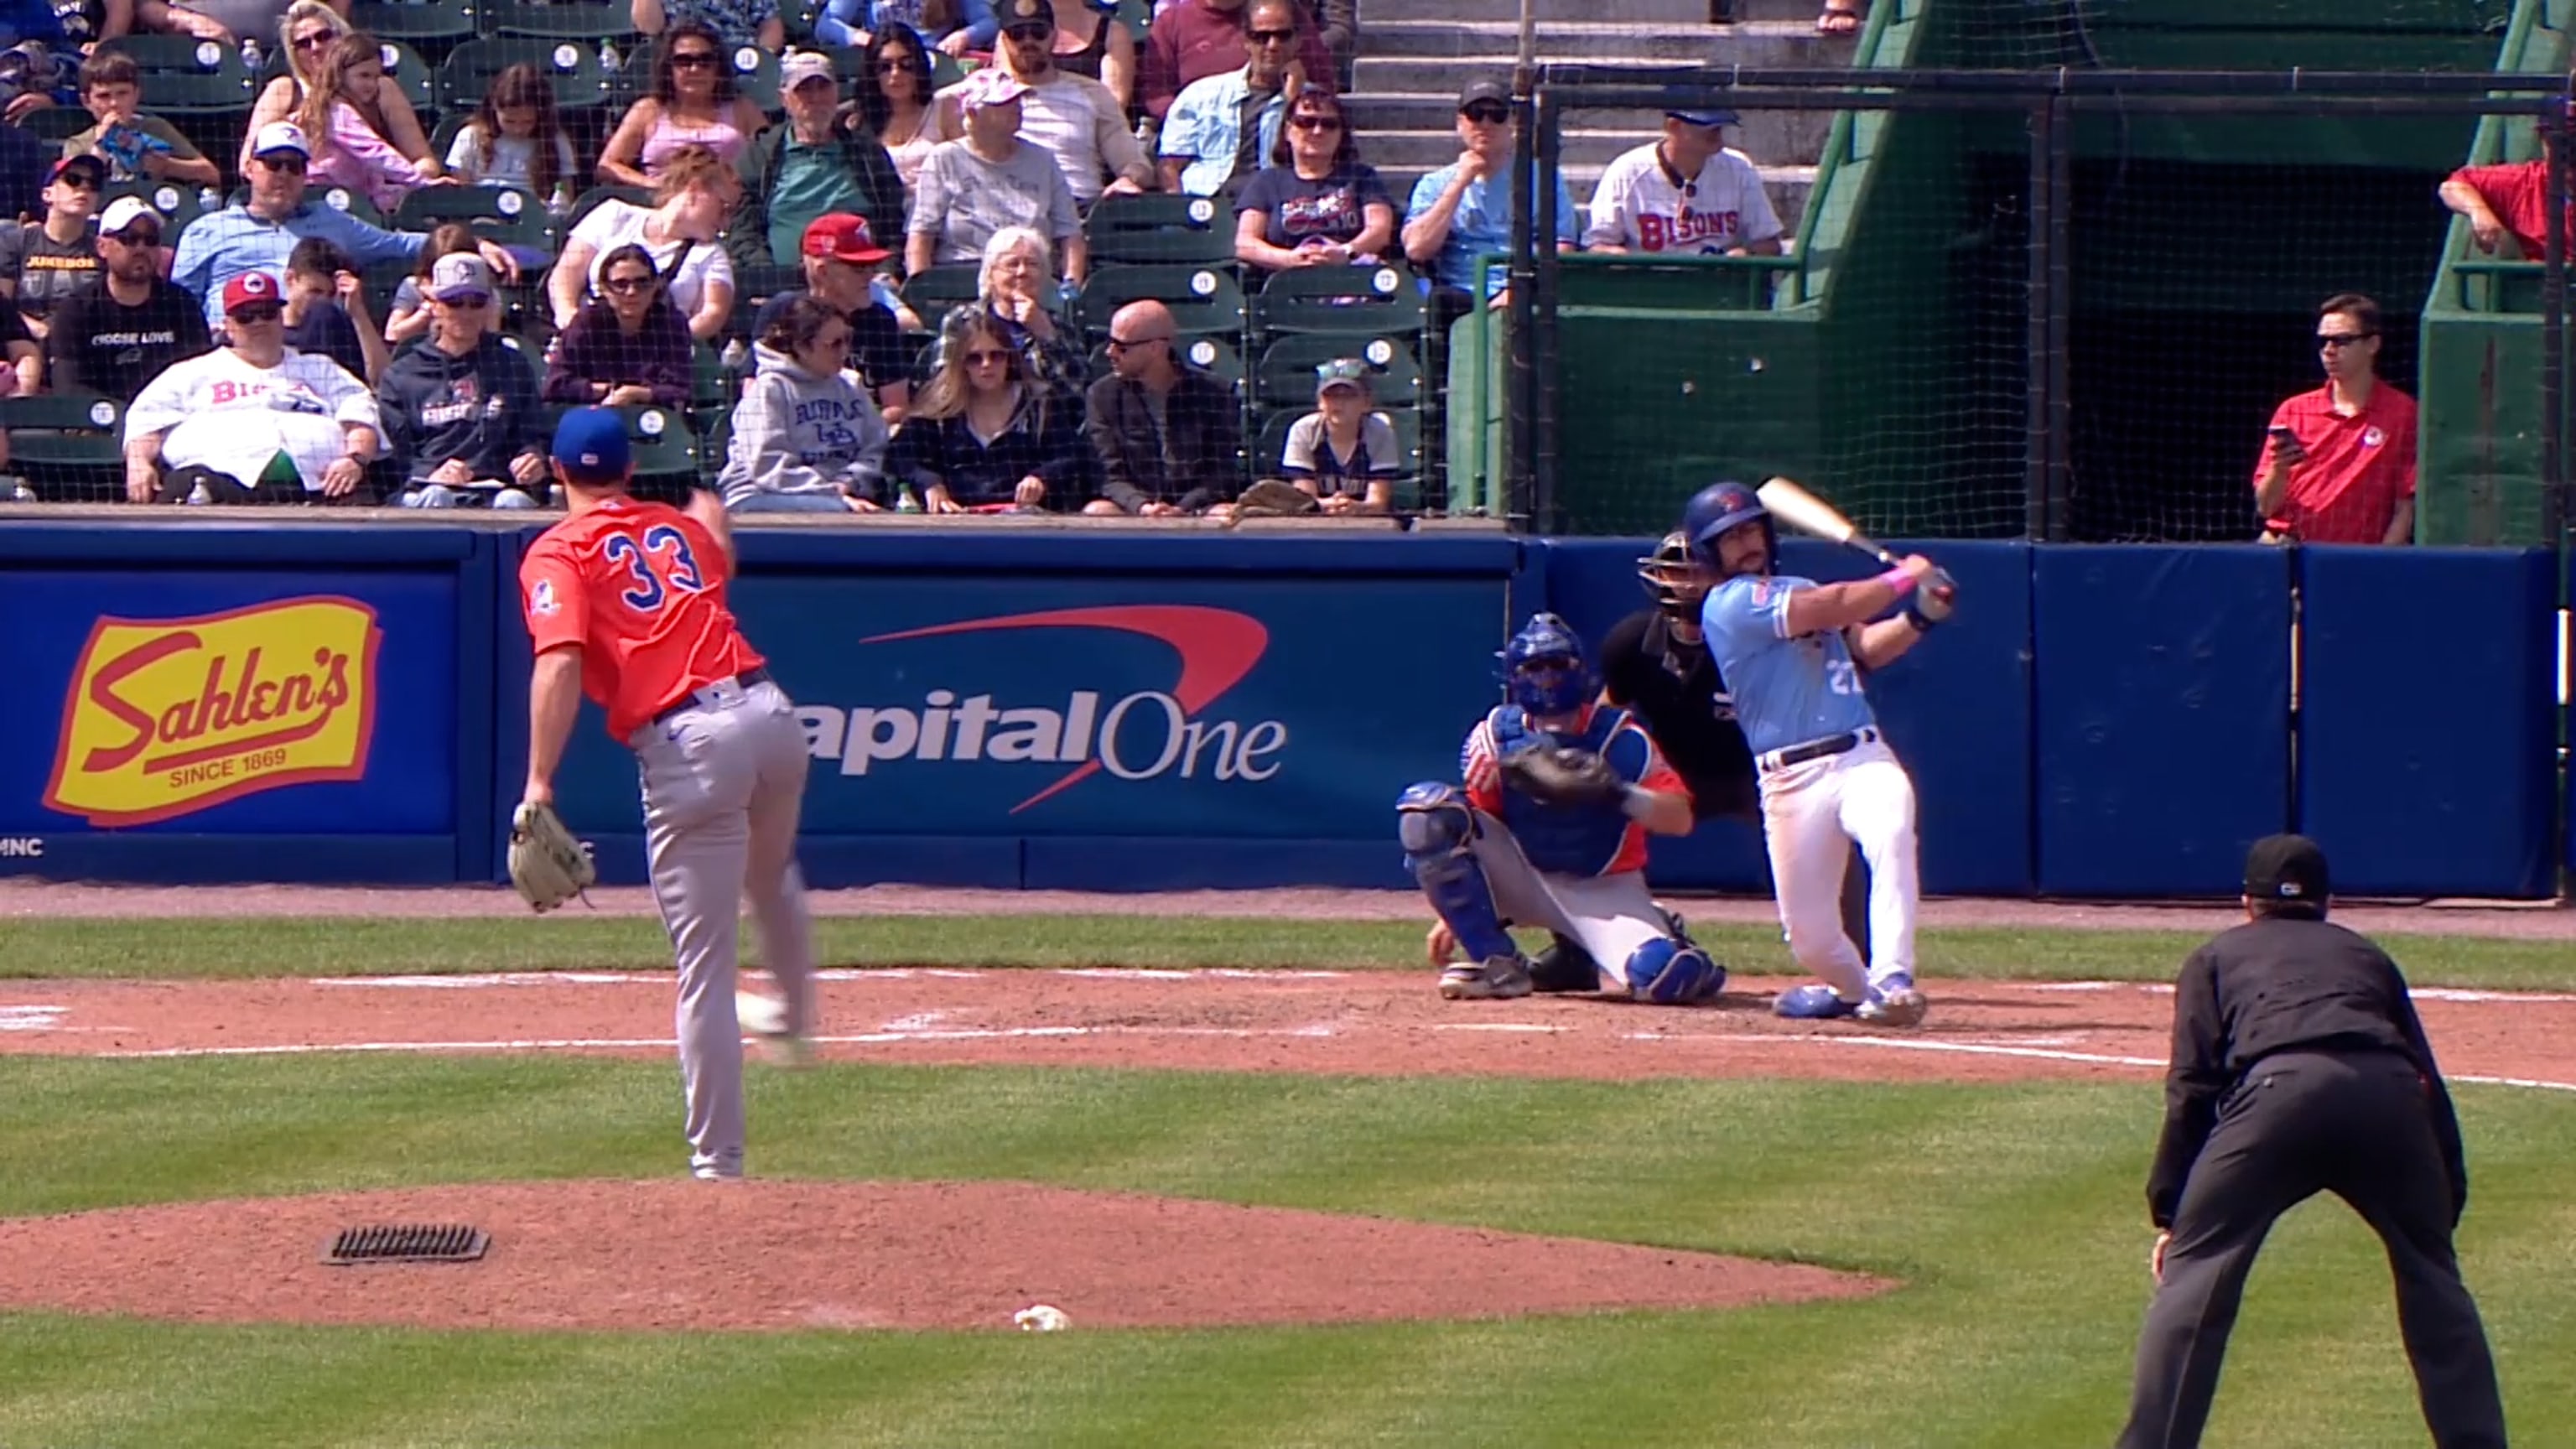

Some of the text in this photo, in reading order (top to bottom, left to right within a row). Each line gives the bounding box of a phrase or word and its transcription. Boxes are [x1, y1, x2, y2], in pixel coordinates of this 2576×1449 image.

[1636, 210, 1739, 252] BISONS
[141, 330, 174, 344] LOVE
[603, 523, 704, 612] 33
[81, 631, 349, 772] Sahlen's
[169, 748, 288, 788] SINCE 1869
[793, 690, 1285, 781] apital One
